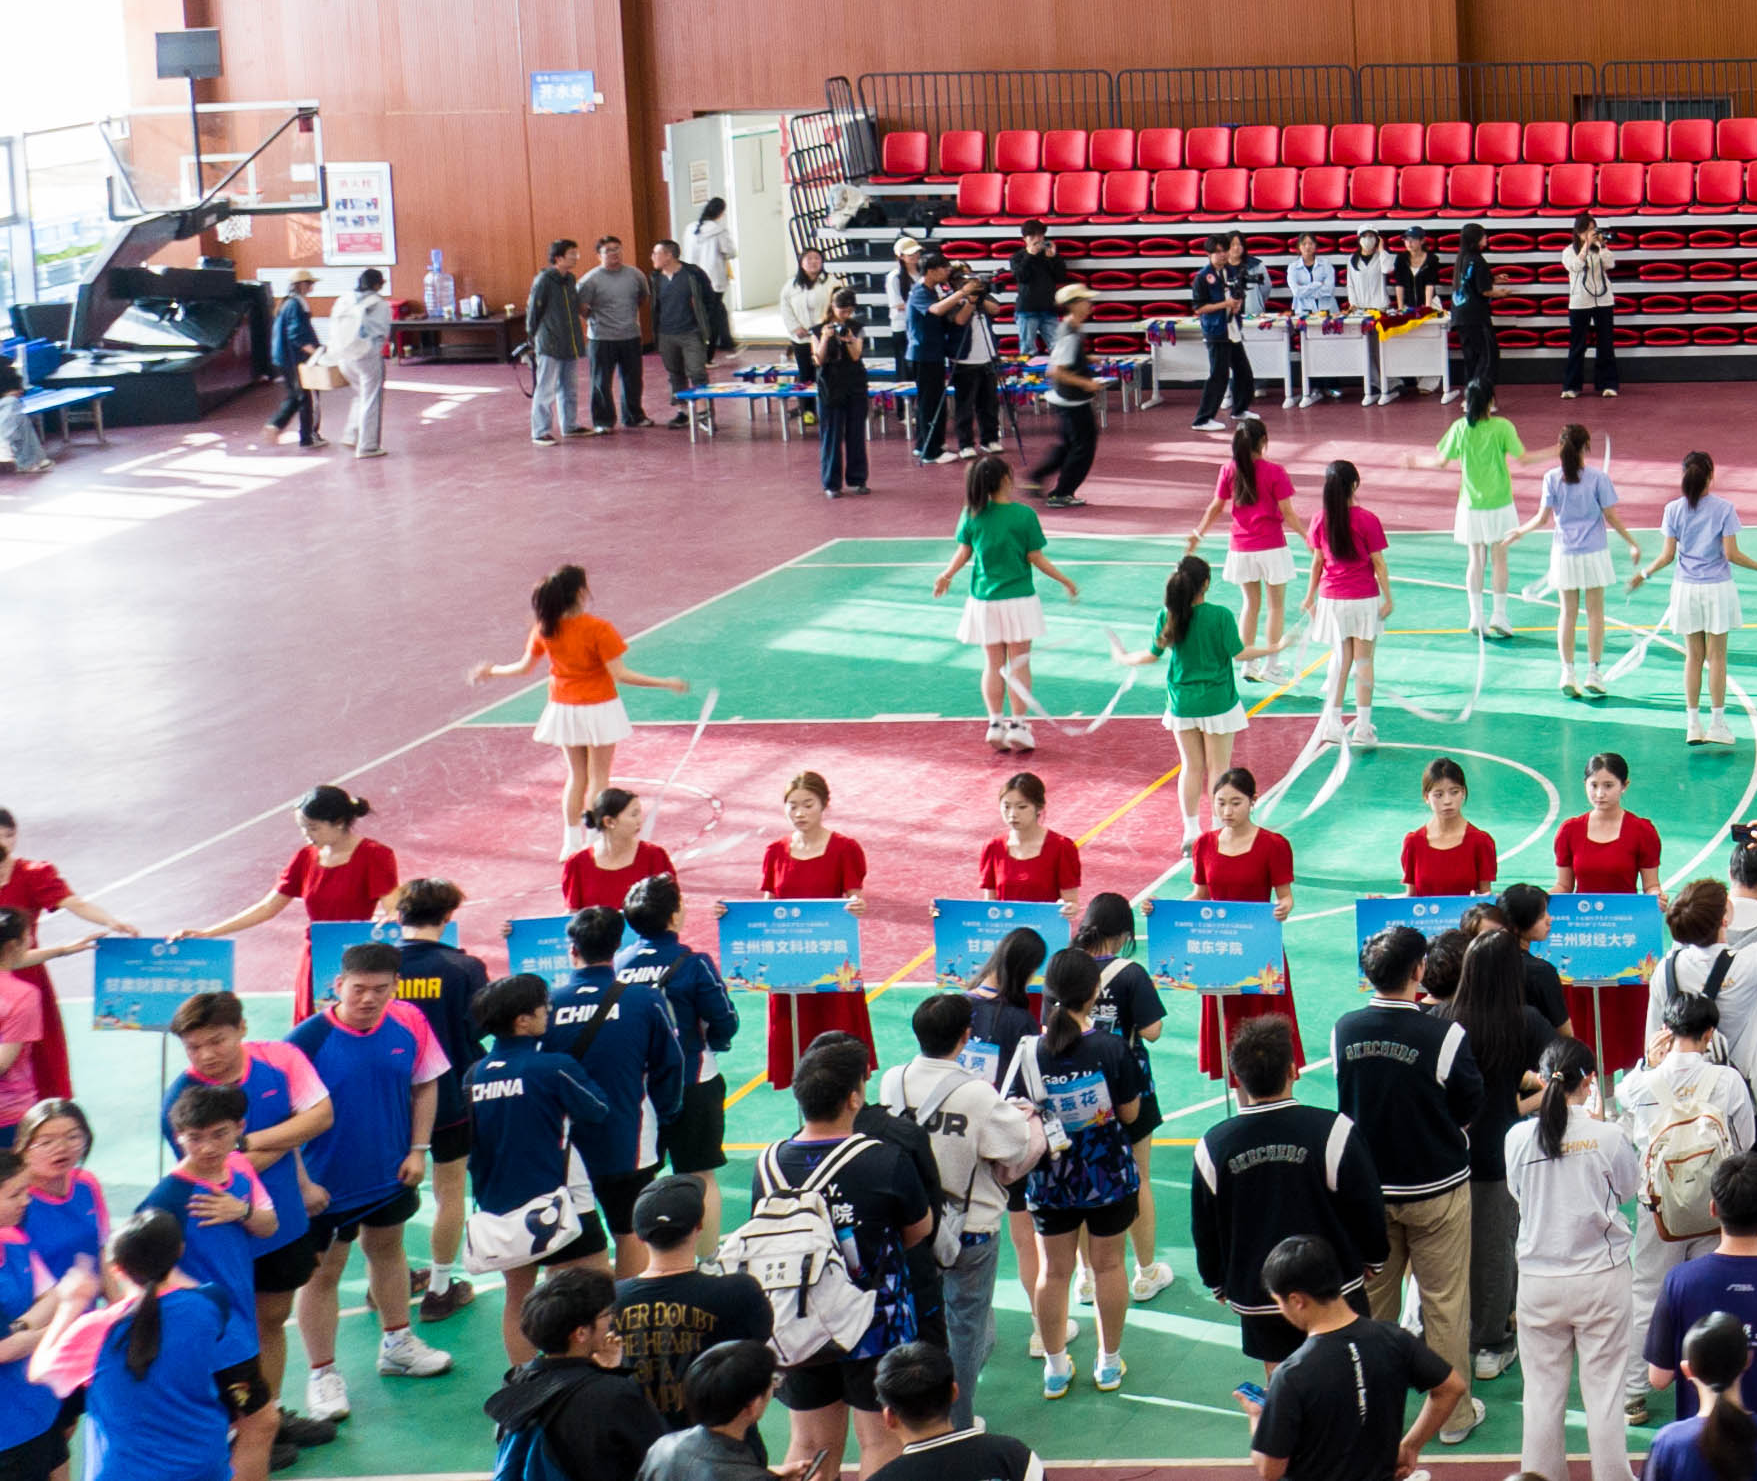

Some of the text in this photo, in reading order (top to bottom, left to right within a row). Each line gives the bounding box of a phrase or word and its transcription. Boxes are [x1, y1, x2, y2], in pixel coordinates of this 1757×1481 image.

[1549, 932, 1638, 948] 兰州财经大学
[1345, 1039, 1420, 1066] SKECHERS
[472, 1078, 524, 1102] CHINA
[1228, 1143, 1309, 1175] SKECHERS
